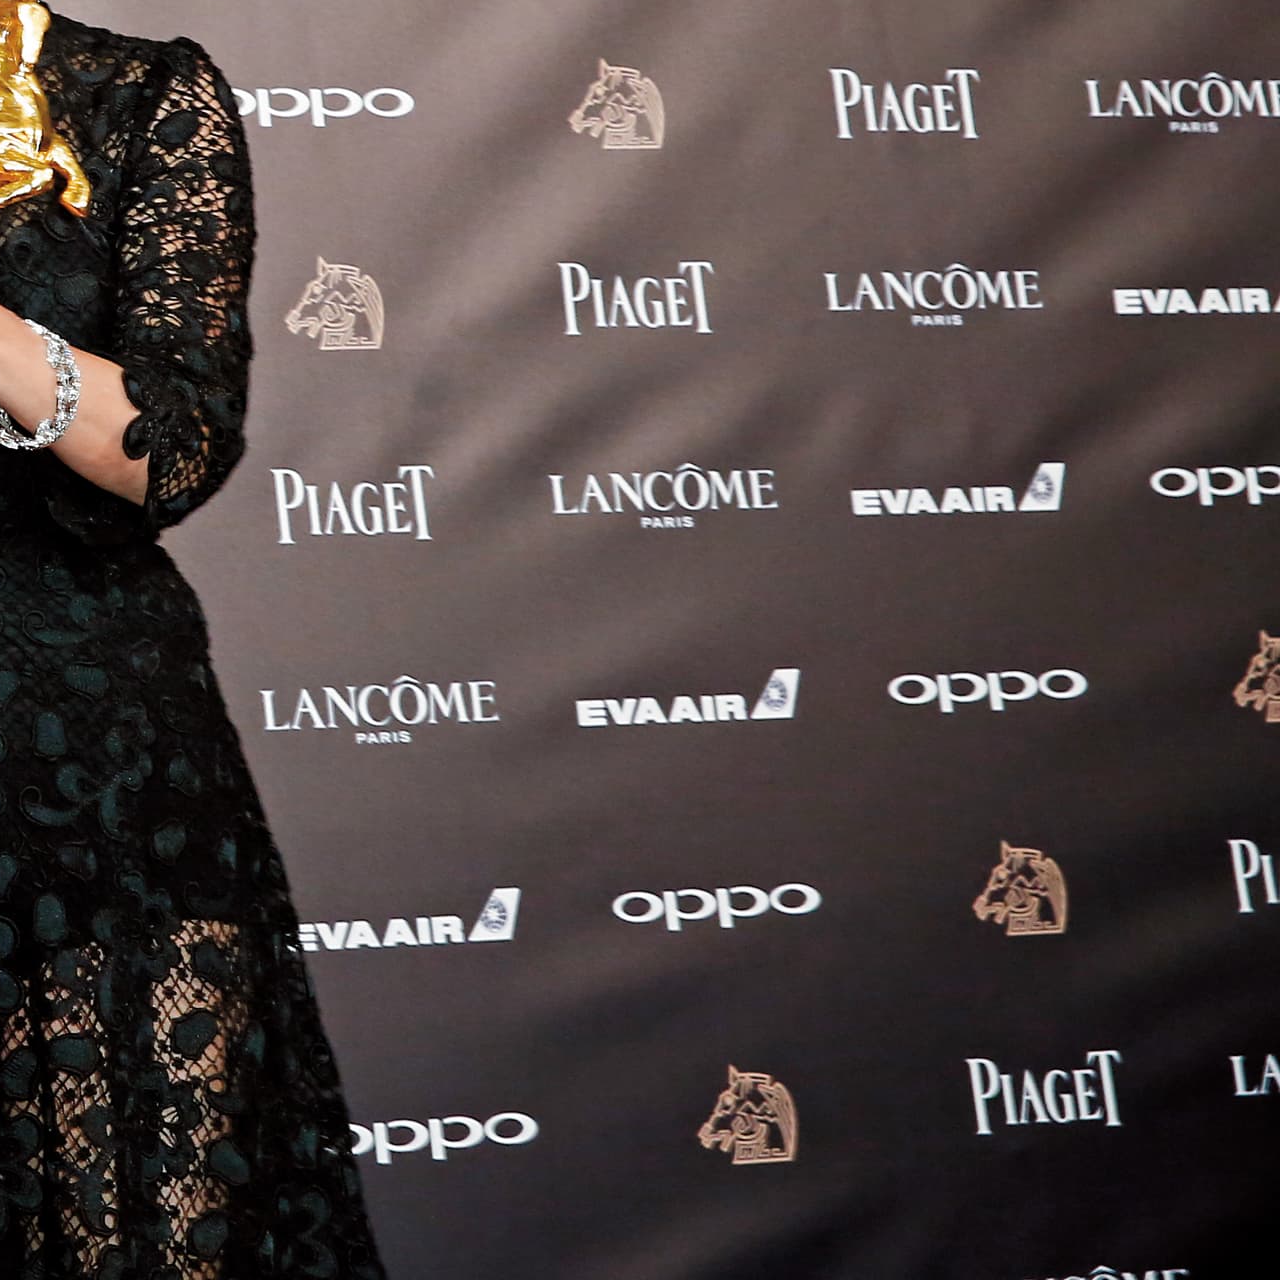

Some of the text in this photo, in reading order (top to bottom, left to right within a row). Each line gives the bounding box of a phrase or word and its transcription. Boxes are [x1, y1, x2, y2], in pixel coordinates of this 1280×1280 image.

[830, 69, 978, 138] PIAGET
[1170, 122, 1218, 132] PARIS
[558, 262, 713, 335] PIAGET
[824, 264, 1043, 310] LANCÔME
[912, 315, 962, 325] PARIS
[271, 466, 434, 543] PIAGET
[549, 463, 778, 513] LANCÔME
[641, 517, 694, 528] PARIS
[260, 676, 499, 730] LANCÔME
[889, 670, 1086, 712] oppo
[356, 731, 410, 744] PARIS
[613, 884, 820, 930] oppo
[966, 1051, 1120, 1134] PIAGET
